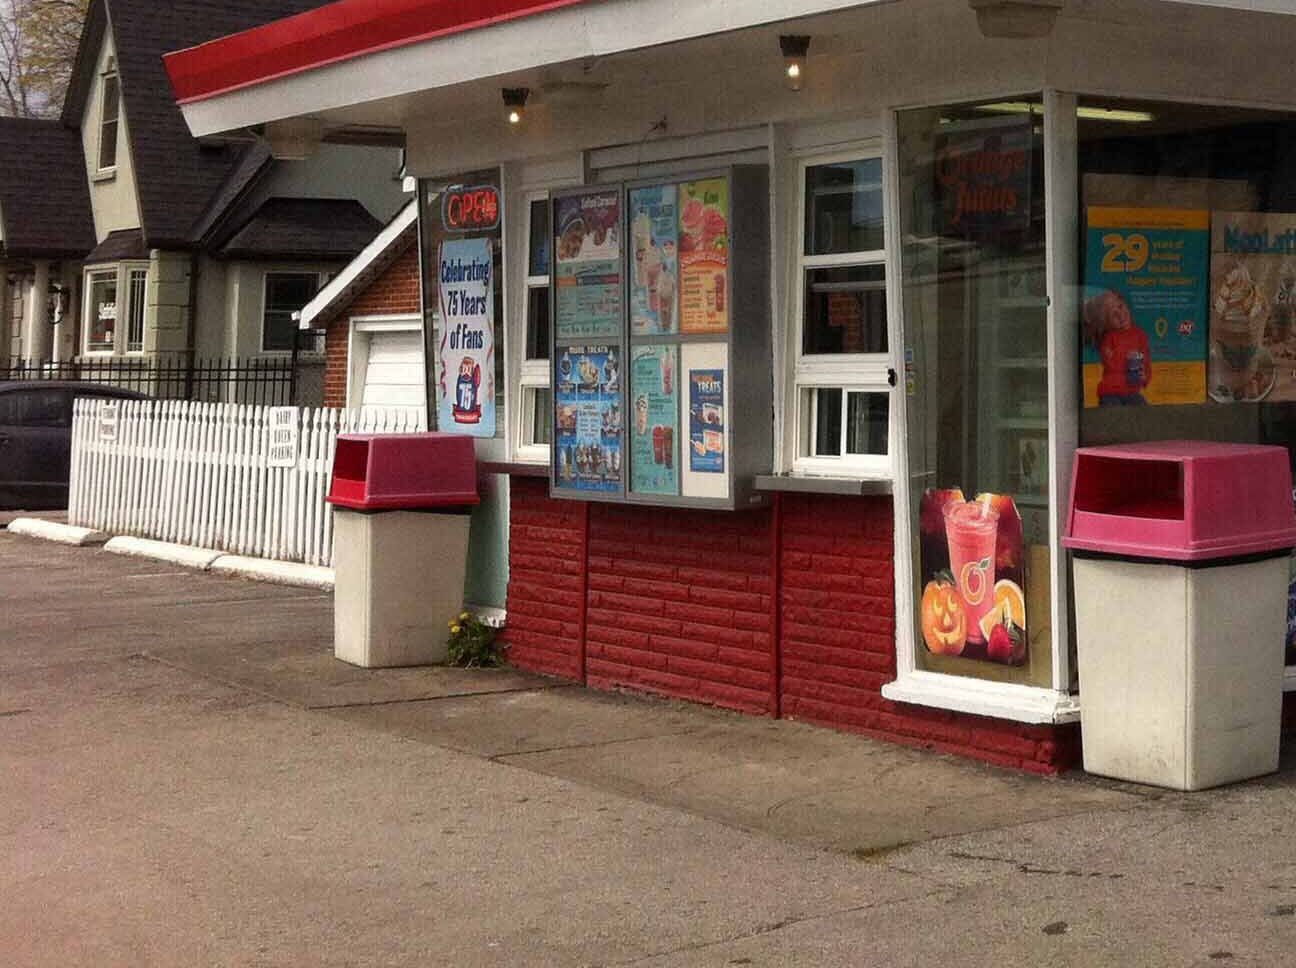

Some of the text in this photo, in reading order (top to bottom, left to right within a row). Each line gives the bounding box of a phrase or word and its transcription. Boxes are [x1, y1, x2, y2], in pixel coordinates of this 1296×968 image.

[448, 189, 497, 226] OPEN
[1101, 233, 1149, 273] 29
[441, 256, 490, 286] Celebrating
[447, 290, 487, 316] 75 Years
[450, 324, 484, 350] of Fans
[459, 383, 473, 410] 75
[698, 381, 722, 394] TREATS
